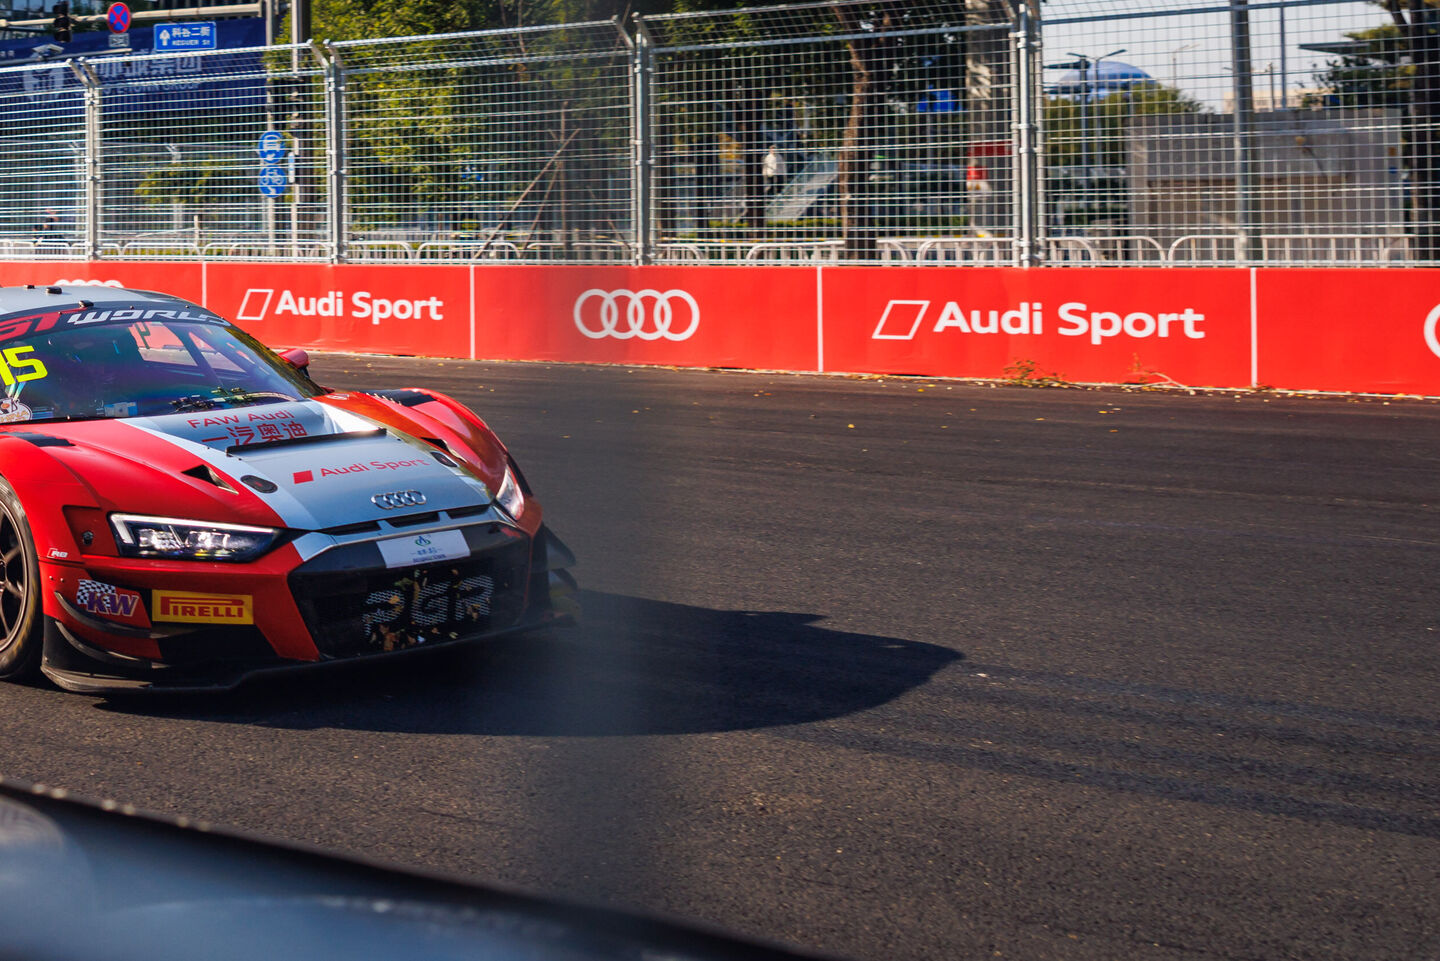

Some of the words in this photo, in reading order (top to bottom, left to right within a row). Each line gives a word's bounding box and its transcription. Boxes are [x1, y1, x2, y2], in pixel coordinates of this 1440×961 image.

[67, 309, 232, 327] WORLD
[274, 290, 343, 316] Audi
[351, 291, 443, 325] Sport
[933, 301, 1043, 334] Audi
[1057, 302, 1206, 345] Sport
[187, 414, 240, 429] FAW
[248, 410, 295, 421] Audi
[201, 420, 308, 447] 一汽奥迪
[320, 463, 366, 477] Audi
[369, 458, 430, 471] Sport
[85, 591, 139, 617] KW
[160, 596, 245, 617] PIRELLI
